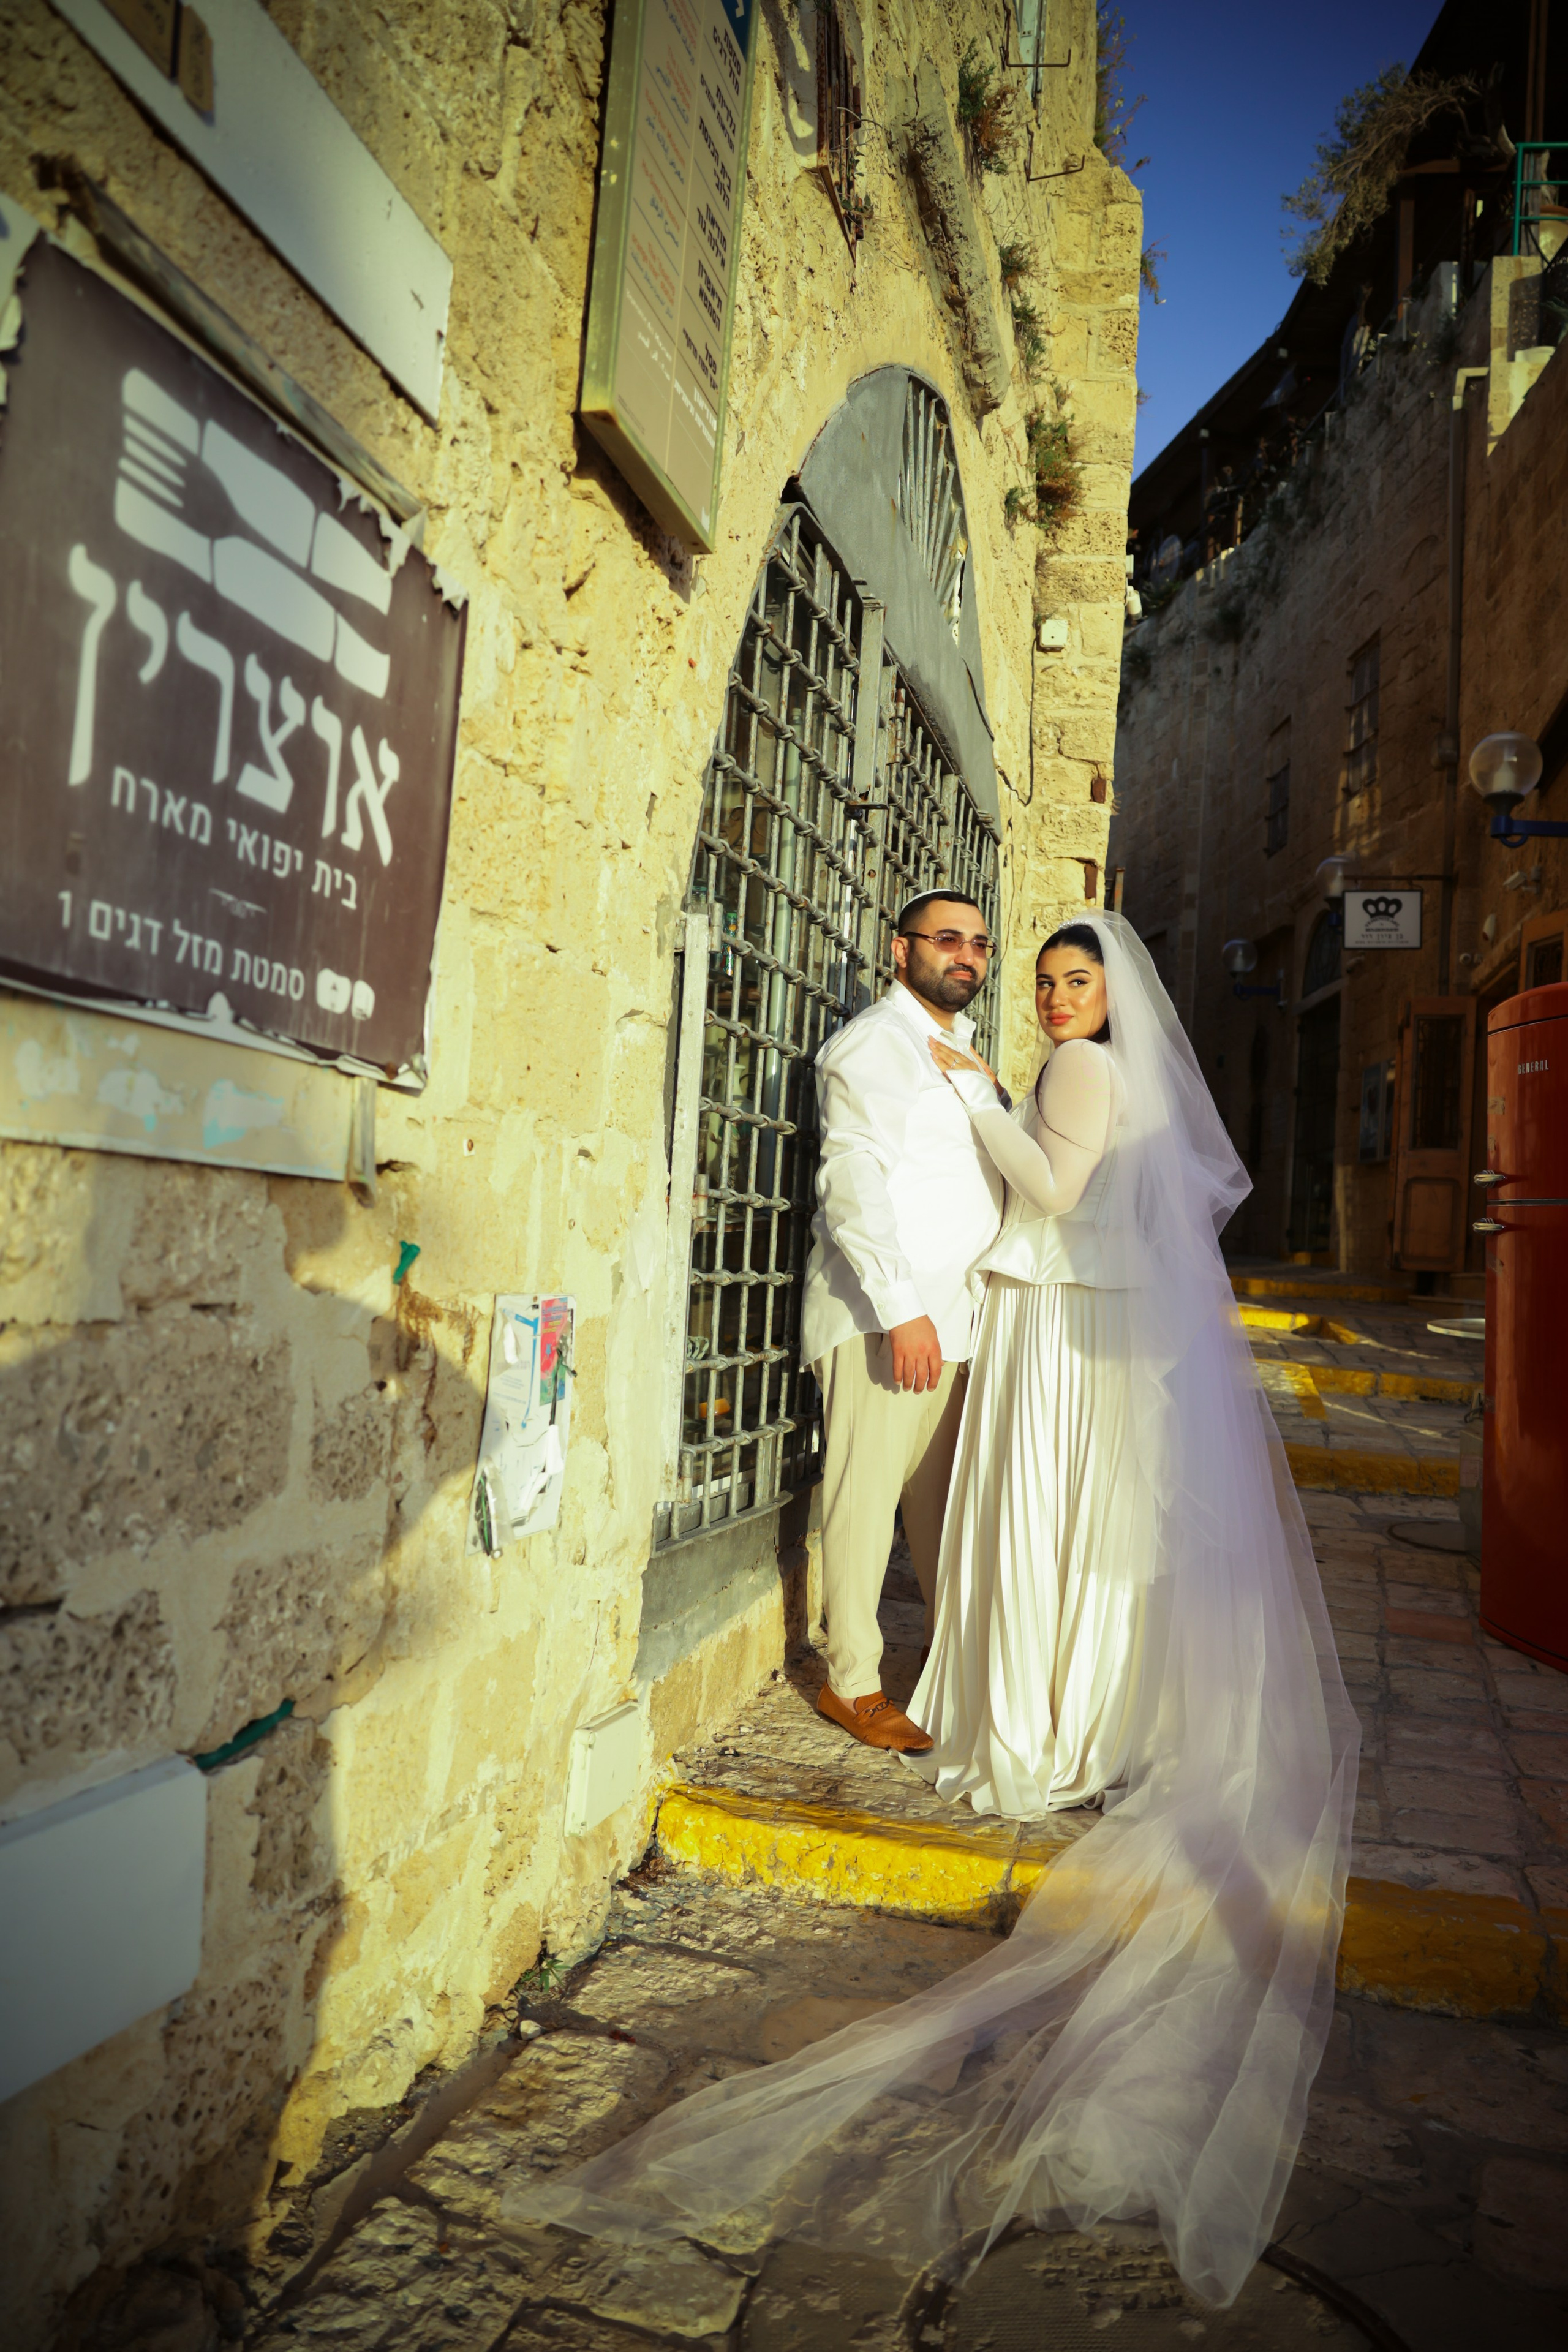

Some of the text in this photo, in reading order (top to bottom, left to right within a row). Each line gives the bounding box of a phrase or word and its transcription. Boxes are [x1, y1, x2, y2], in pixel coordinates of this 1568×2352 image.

[713, 25, 739, 96] מזל דגים
[724, 28, 741, 77] סמטת
[716, 83, 736, 137] גלריות
[699, 116, 731, 192] בית הכנסת
[714, 167, 729, 211] הלובי
[696, 206, 725, 271] אילנה גור
[706, 202, 726, 253] מוזיאון
[698, 258, 722, 314] תיאטרון
[699, 284, 720, 332] הסמטא
[704, 342, 717, 375] פסל
[694, 386, 718, 436] מוזיאון
[111, 766, 212, 844] מארח
[227, 818, 303, 878] יפואי
[312, 859, 358, 910] בית
[58, 891, 305, 1001] סמטת מזל דגים 1
[1518, 1060, 1549, 1075] GENERAL
